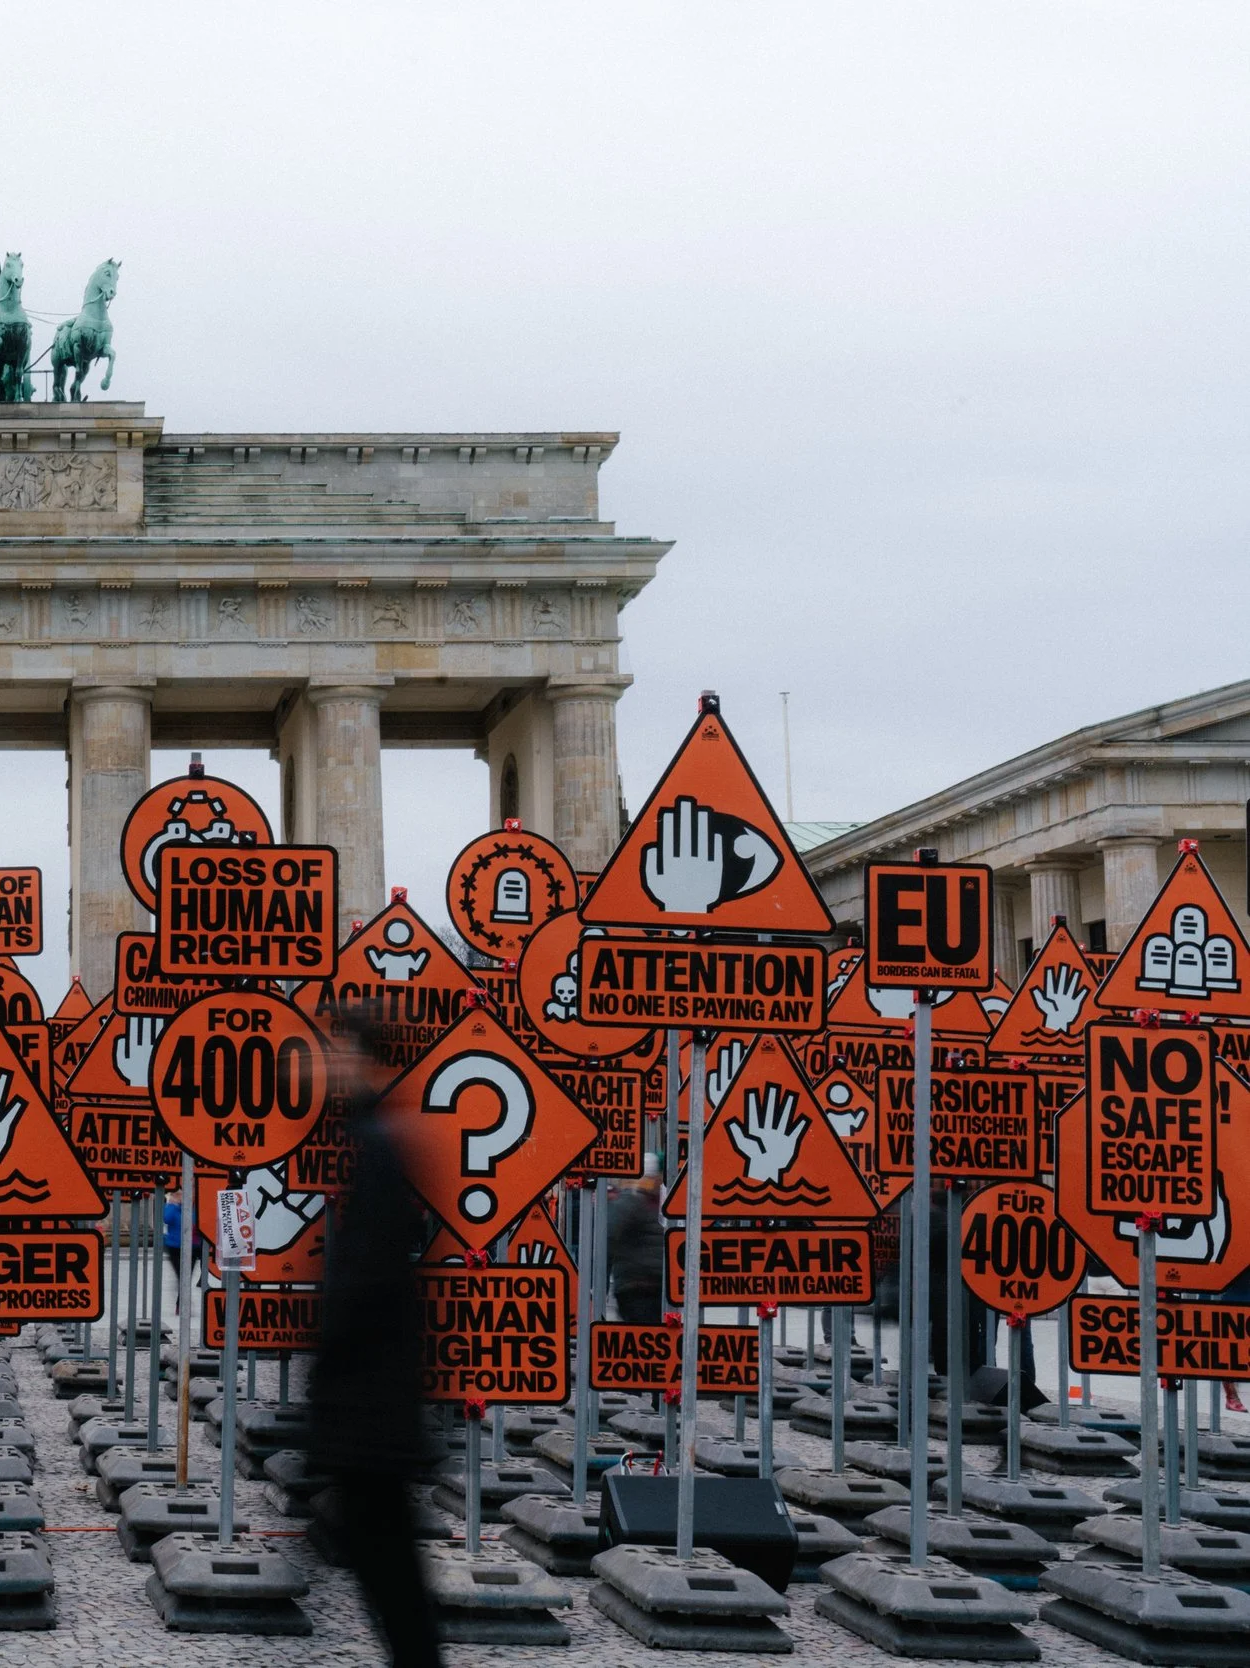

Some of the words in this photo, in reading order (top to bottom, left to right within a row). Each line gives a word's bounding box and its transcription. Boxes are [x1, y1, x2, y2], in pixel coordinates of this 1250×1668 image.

[170, 857, 266, 886] LOSS
[272, 858, 323, 886] OF
[170, 889, 323, 932] HUMAN
[877, 873, 981, 967] EU
[170, 934, 323, 966] RIGHTS
[590, 948, 815, 998] ATTENTION
[877, 964, 919, 979] BORDERS
[922, 966, 939, 979] CAN
[941, 967, 953, 979] BE
[954, 966, 981, 980] FATAL
[208, 1007, 273, 1033] FOR
[589, 992, 620, 1016] NO
[622, 994, 664, 1018] ONE
[669, 996, 689, 1018] IS
[692, 997, 766, 1022] PAYING
[768, 1000, 814, 1024] ANY
[836, 1041, 980, 1069] WARNG
[1099, 1036, 1203, 1096] NO
[161, 1034, 313, 1120] 4000
[76, 1112, 172, 1148] ATTEN
[213, 1122, 265, 1147] KM
[1100, 1096, 1203, 1142] SAFE
[101, 1147, 131, 1165] ONE
[134, 1148, 149, 1166] IS
[610, 1135, 636, 1150] AUF
[1101, 1141, 1203, 1173] ESCAPE
[297, 1149, 356, 1185] WEG
[997, 1189, 1045, 1214] FÜR
[1101, 1173, 1203, 1205] ROUTES
[961, 1213, 1076, 1282] 4000
[418, 1276, 556, 1299] TTENTION
[678, 1275, 776, 1295] ETRINKEN
[778, 1275, 800, 1295] IM
[802, 1275, 864, 1295] GANGE
[1000, 1279, 1039, 1300] KM
[427, 1300, 557, 1333] UMAN
[1079, 1304, 1250, 1340] SCROLLIN
[214, 1330, 271, 1343] GWALT
[272, 1330, 293, 1343] AN
[426, 1335, 558, 1368] IGHTS
[597, 1331, 672, 1361] MASS
[1080, 1335, 1170, 1367] PAST
[1175, 1340, 1250, 1372] KILL
[421, 1369, 455, 1392] OT
[459, 1369, 558, 1393] FOUND
[597, 1361, 667, 1383] ZONE
